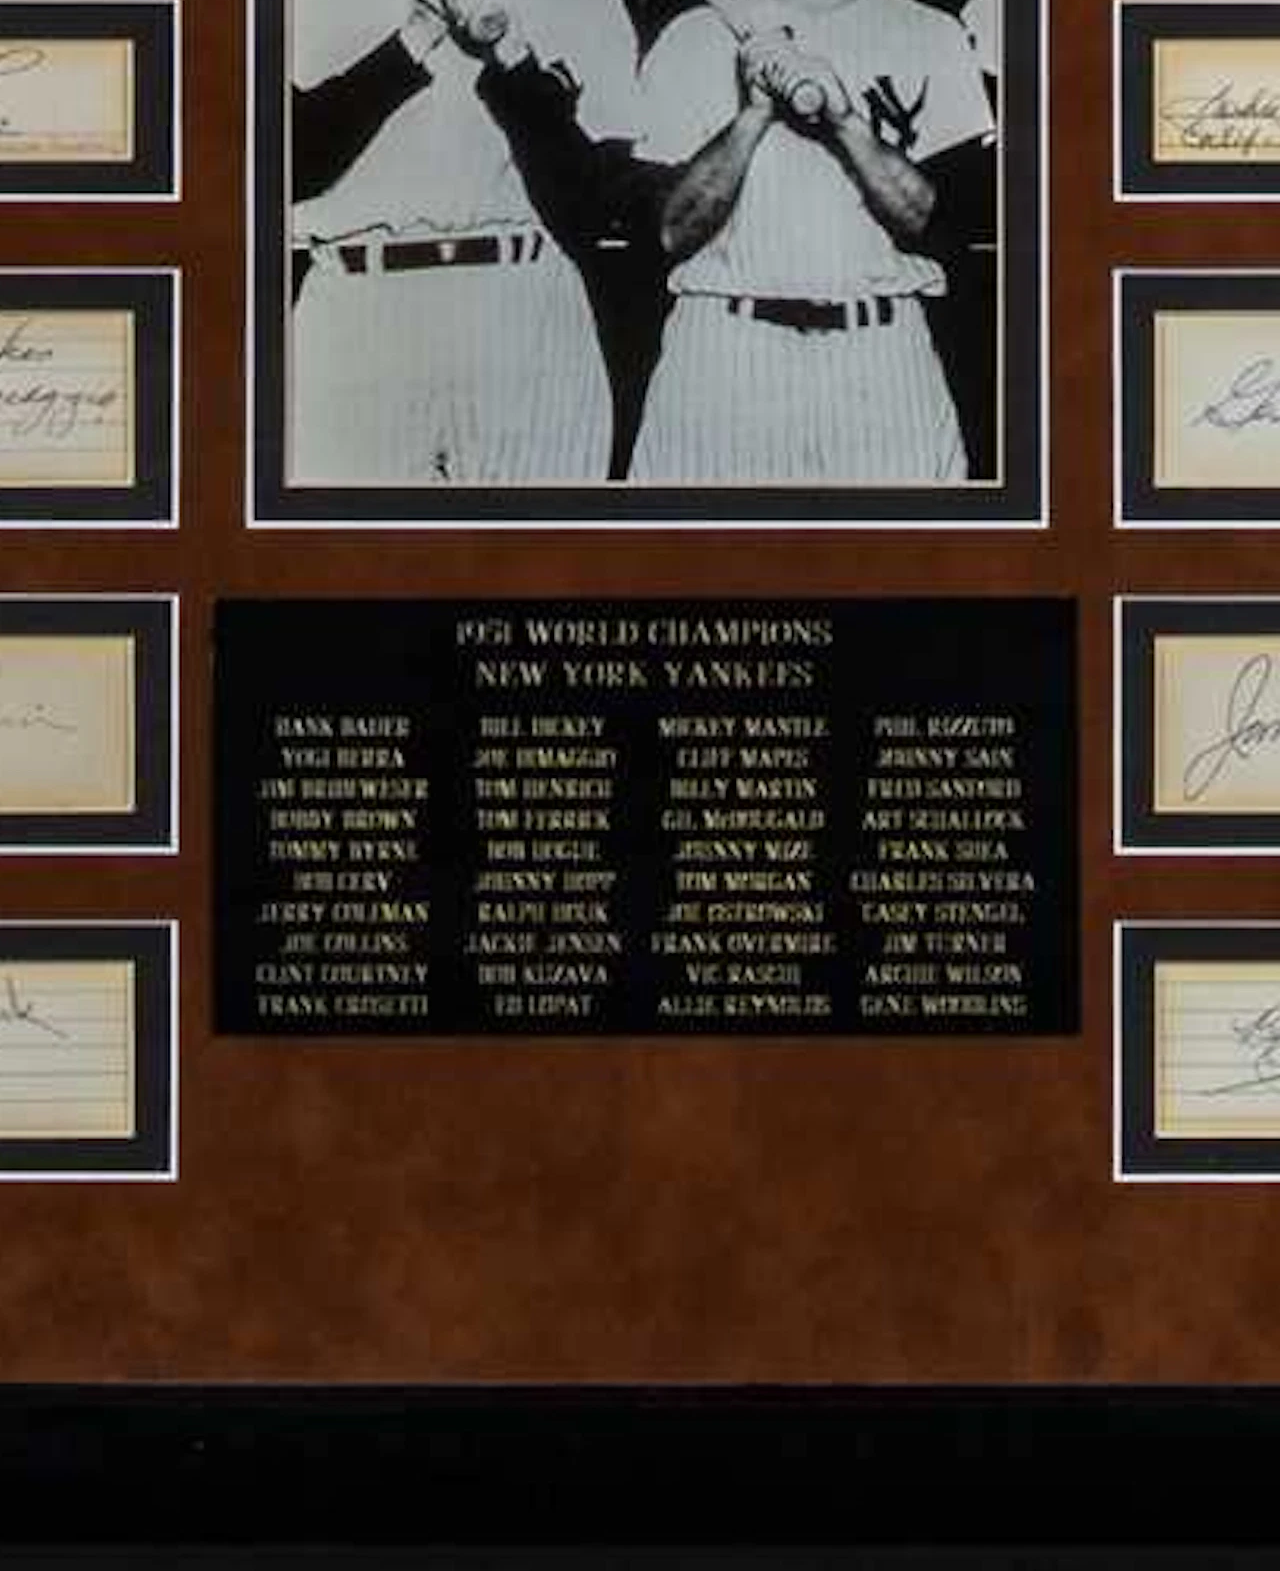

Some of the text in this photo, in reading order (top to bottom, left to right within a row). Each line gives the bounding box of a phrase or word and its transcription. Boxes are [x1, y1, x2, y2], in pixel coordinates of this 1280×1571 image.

[525, 619, 640, 646] WORLD
[647, 619, 834, 646] CHAMPIONS
[475, 660, 814, 687] NEW YORK YANKEES
